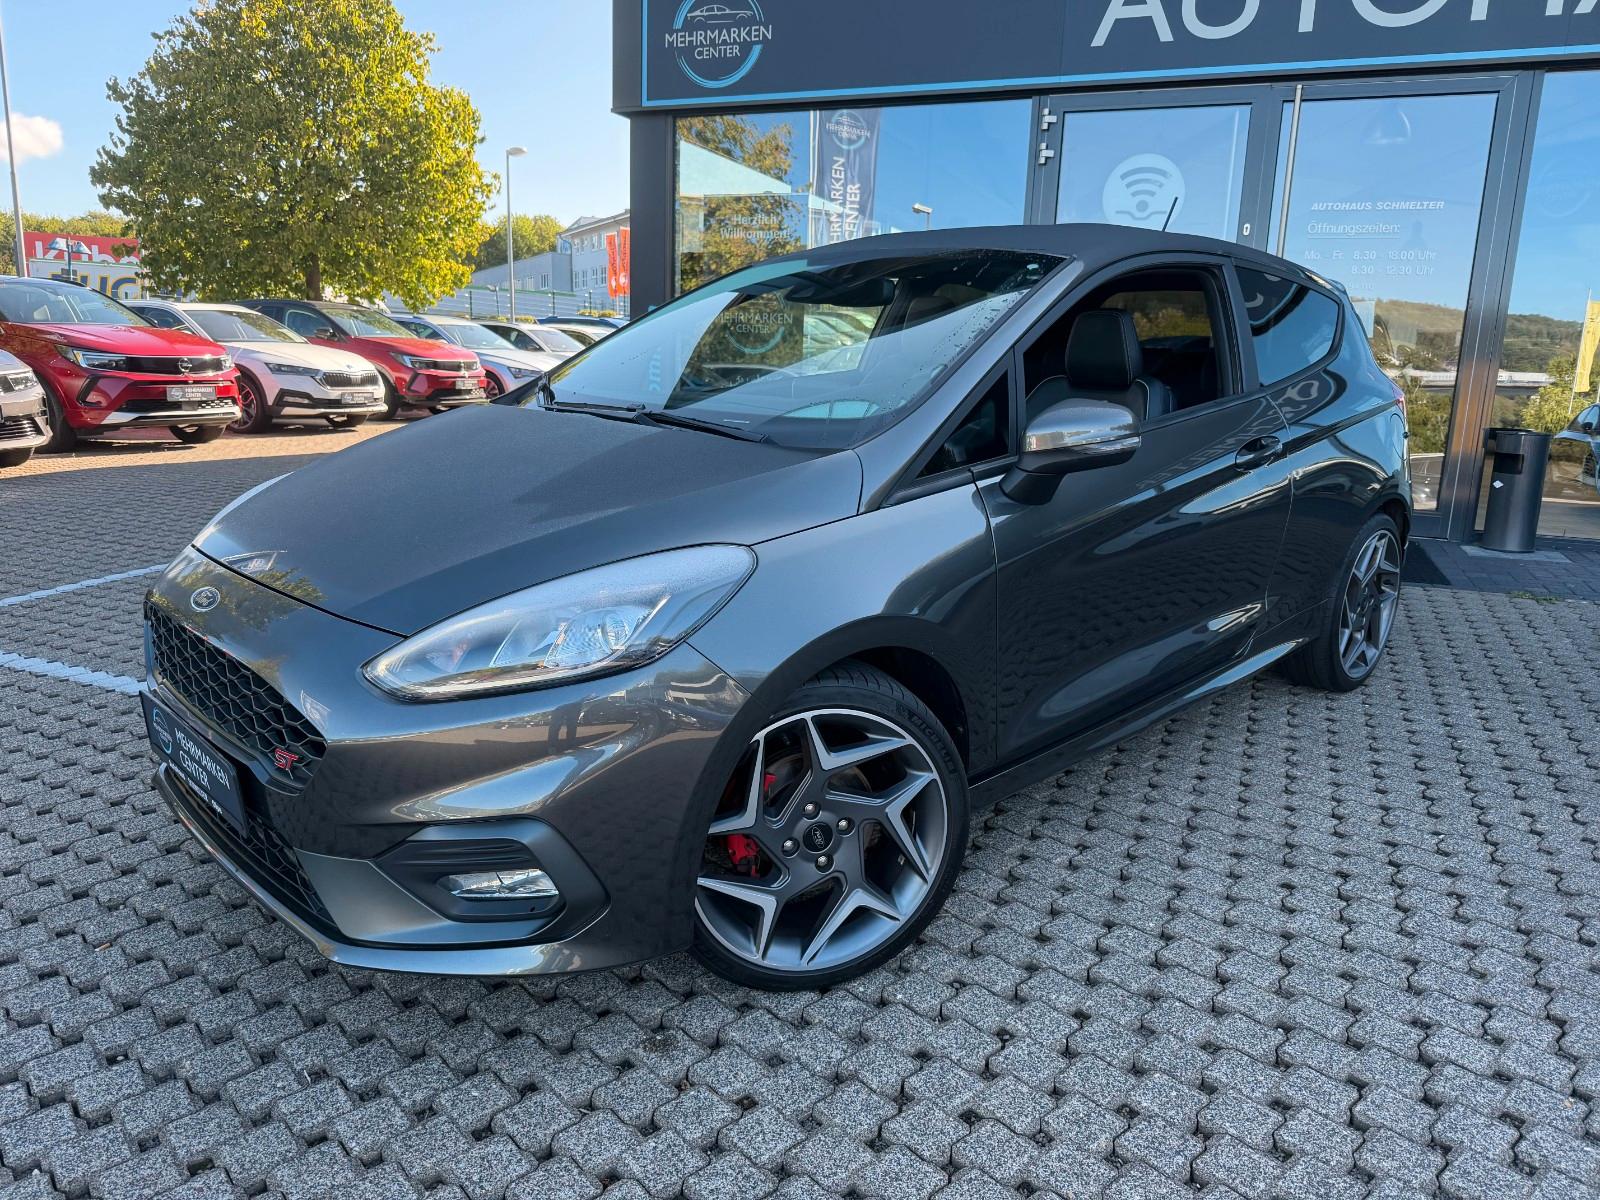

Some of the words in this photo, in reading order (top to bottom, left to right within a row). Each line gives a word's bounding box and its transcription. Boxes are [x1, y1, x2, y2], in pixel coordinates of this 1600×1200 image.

[665, 24, 773, 48] MEHRMARKEN
[694, 44, 741, 60] CENTER
[1311, 201, 1373, 211] AUTOHAUS
[1375, 200, 1446, 211] SCHMELTER
[733, 213, 777, 225] Herzlich
[1353, 250, 1377, 261] 8.30
[1351, 265, 1375, 275] 8.30
[736, 324, 769, 334] CENTER
[174, 726, 231, 791] MEHRMARKEN
[274, 748, 299, 771] ST
[178, 749, 211, 792] CENTER
